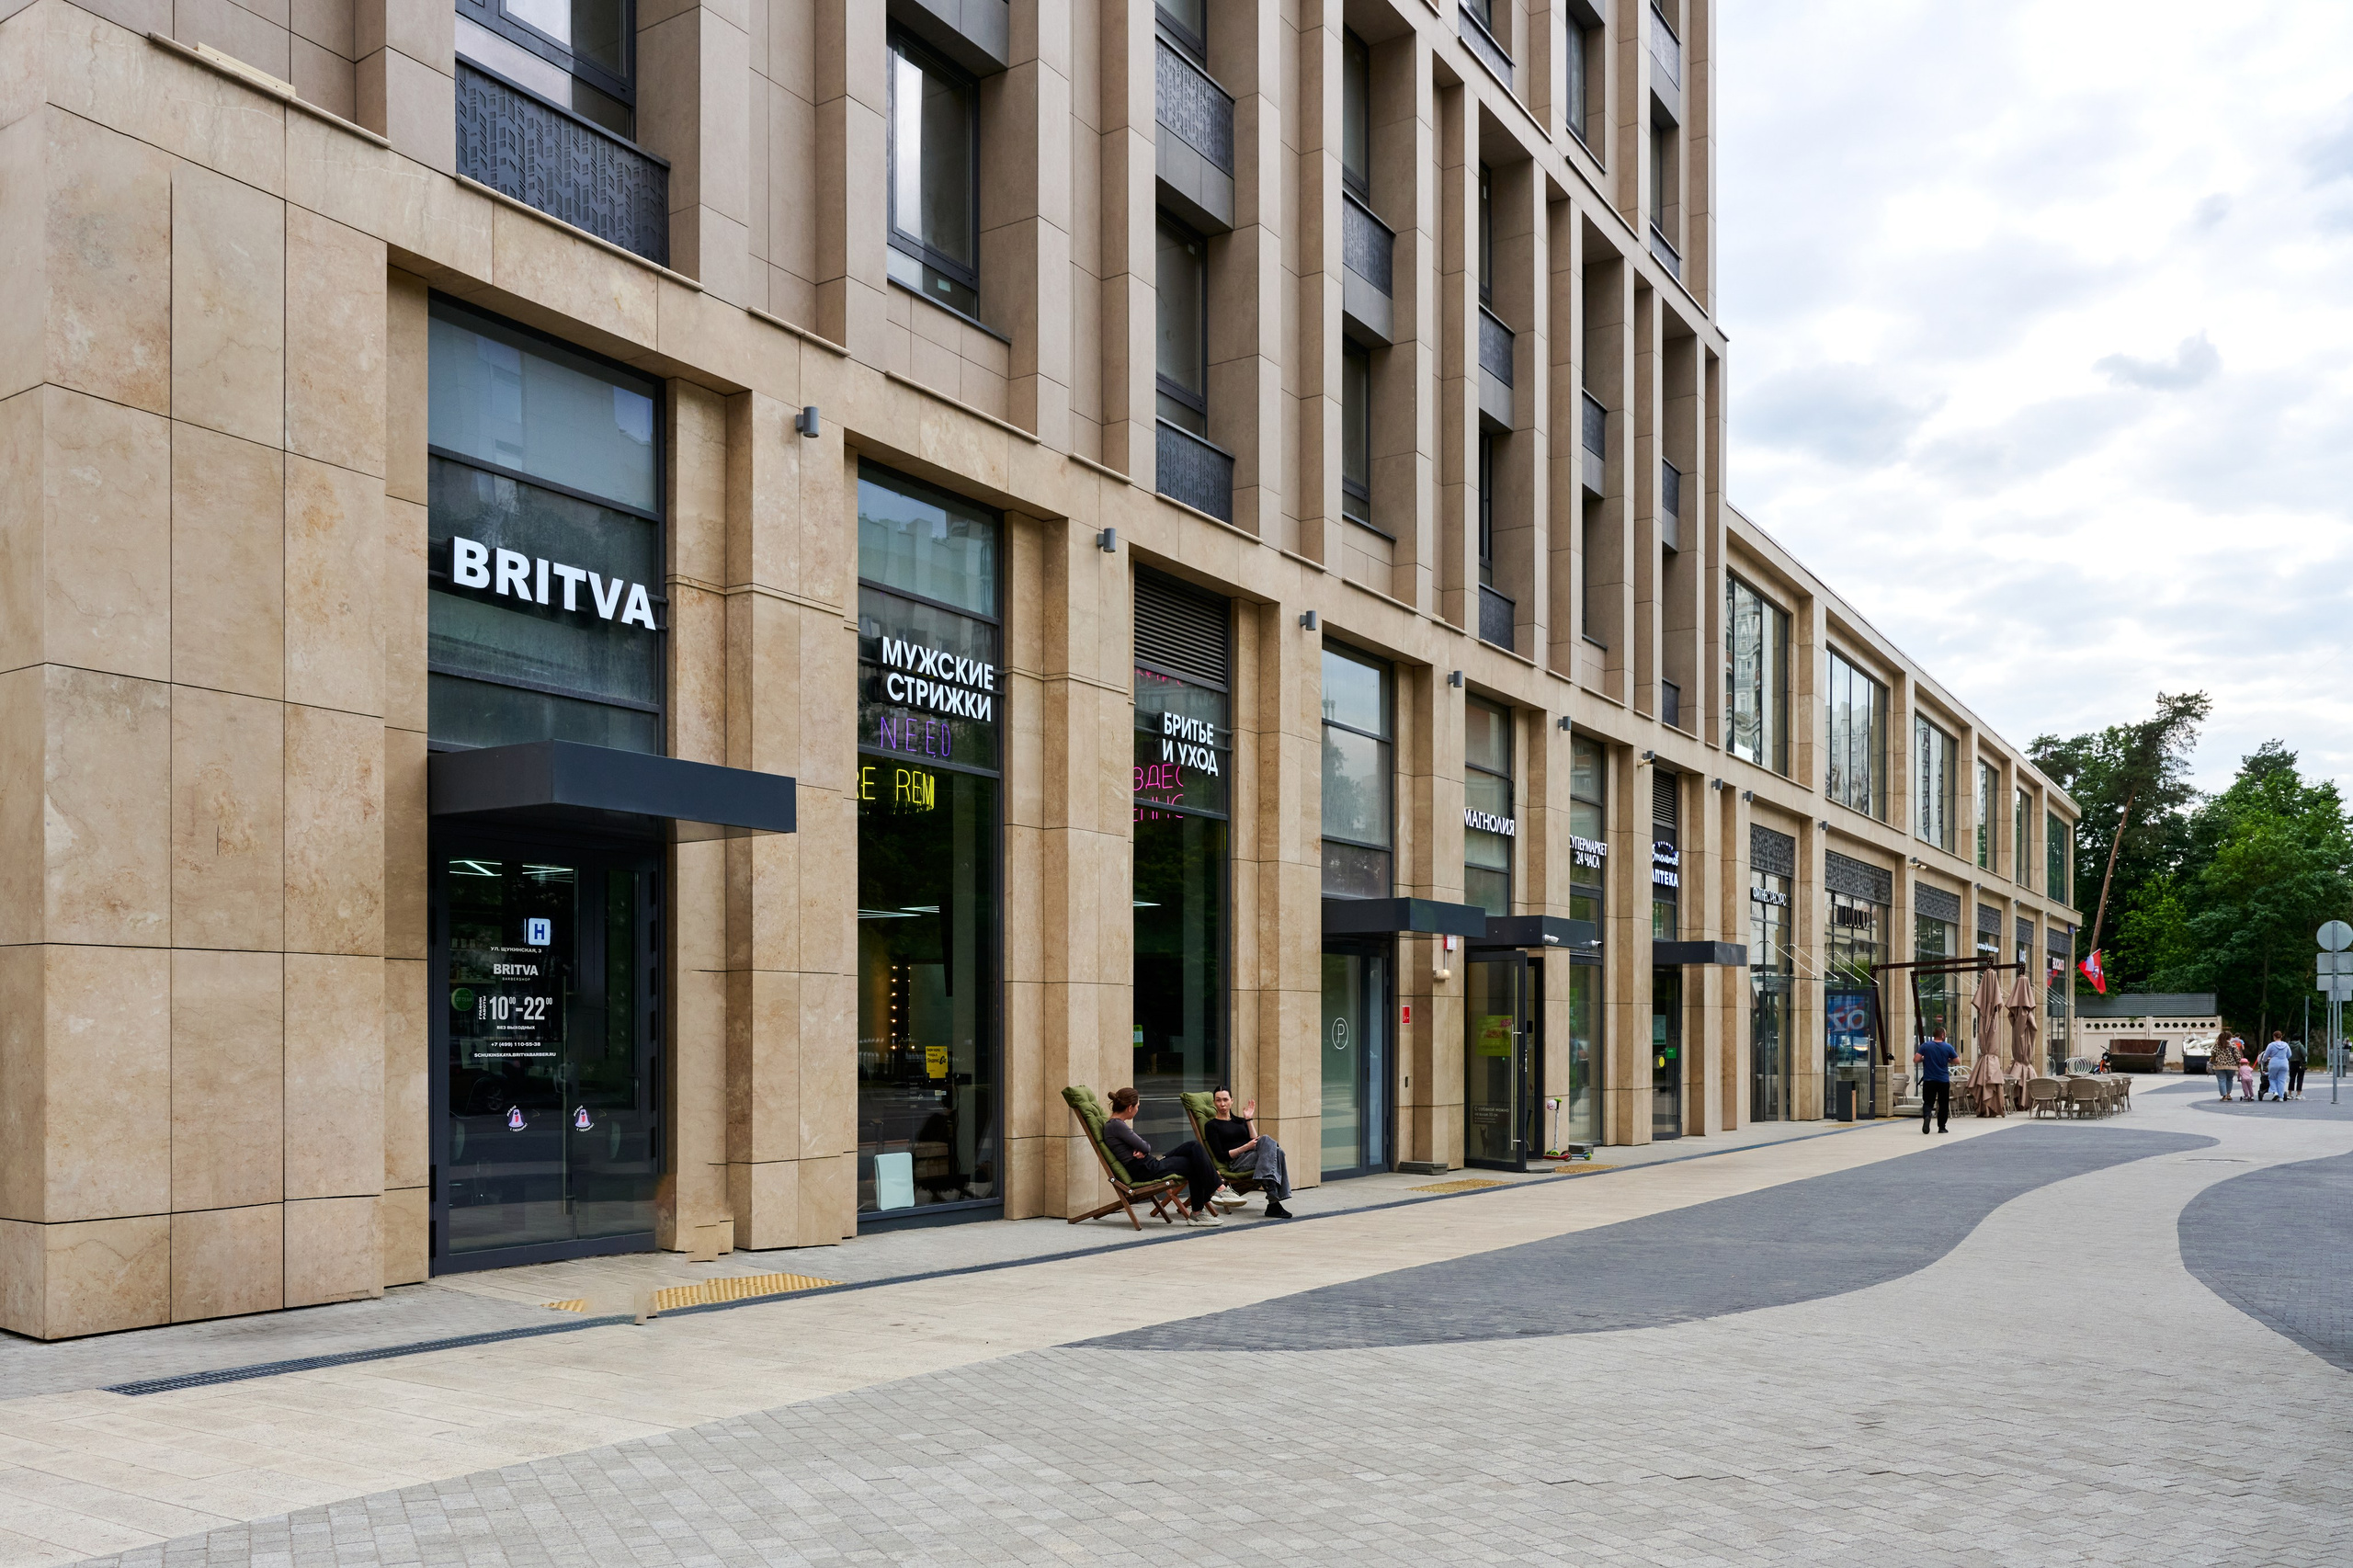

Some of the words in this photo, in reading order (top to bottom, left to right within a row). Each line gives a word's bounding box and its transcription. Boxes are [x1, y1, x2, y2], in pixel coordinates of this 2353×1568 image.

[452, 535, 656, 631] BRITVA
[882, 636, 994, 691] МУЖСКИЕ
[887, 672, 992, 722] СТРИЖКИ
[881, 716, 951, 756] NEED
[1164, 710, 1214, 745] БРИТЬЕ
[1162, 738, 1174, 763] И
[1177, 742, 1219, 777] УХОД
[1464, 808, 1515, 836] МАГНОЛИЯ
[1570, 834, 1608, 857] УПЕРМАРКЕТ
[1576, 850, 1584, 866] 24
[1585, 852, 1600, 869] ЧАСА
[493, 963, 539, 976] BRITVA
